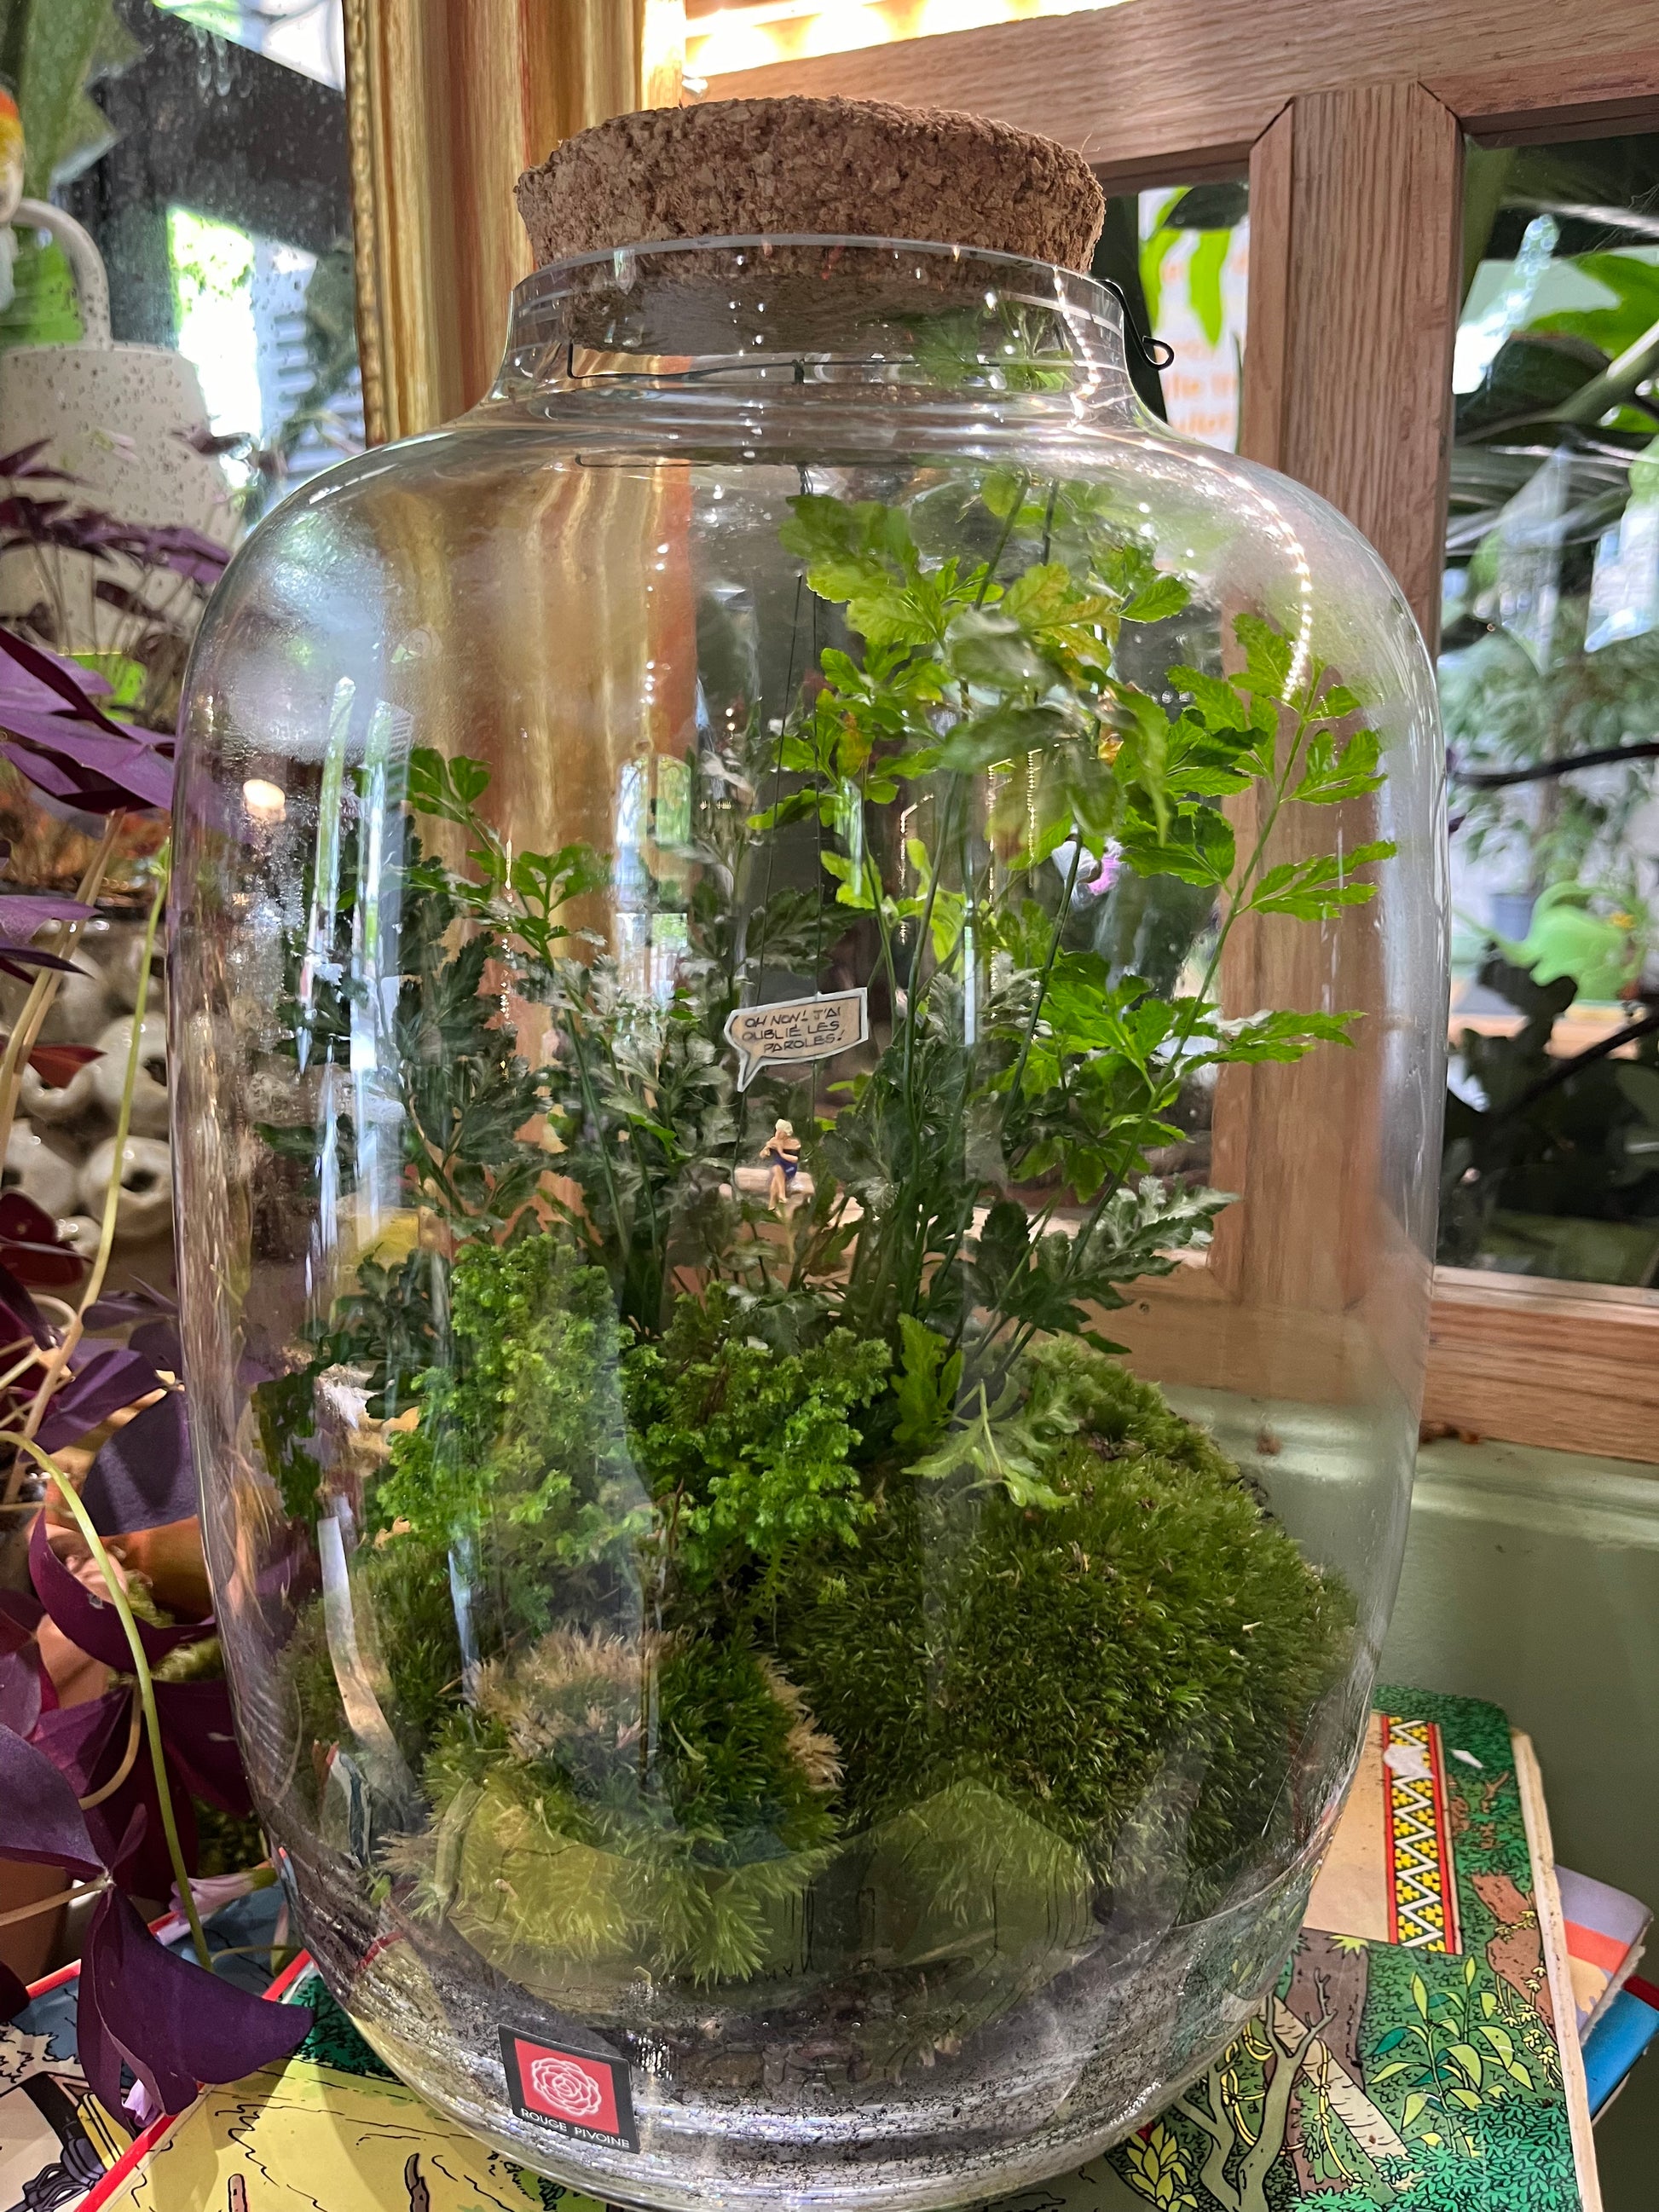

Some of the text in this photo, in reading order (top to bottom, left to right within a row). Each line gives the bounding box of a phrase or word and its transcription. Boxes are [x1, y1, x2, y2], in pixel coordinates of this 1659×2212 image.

[745, 1007, 841, 1028] OH NON! J'AI
[743, 1020, 840, 1041] OUBLIÉ LES
[764, 1030, 845, 1054] PAROLES!
[521, 2108, 630, 2149] ROUGE PIVOINE
